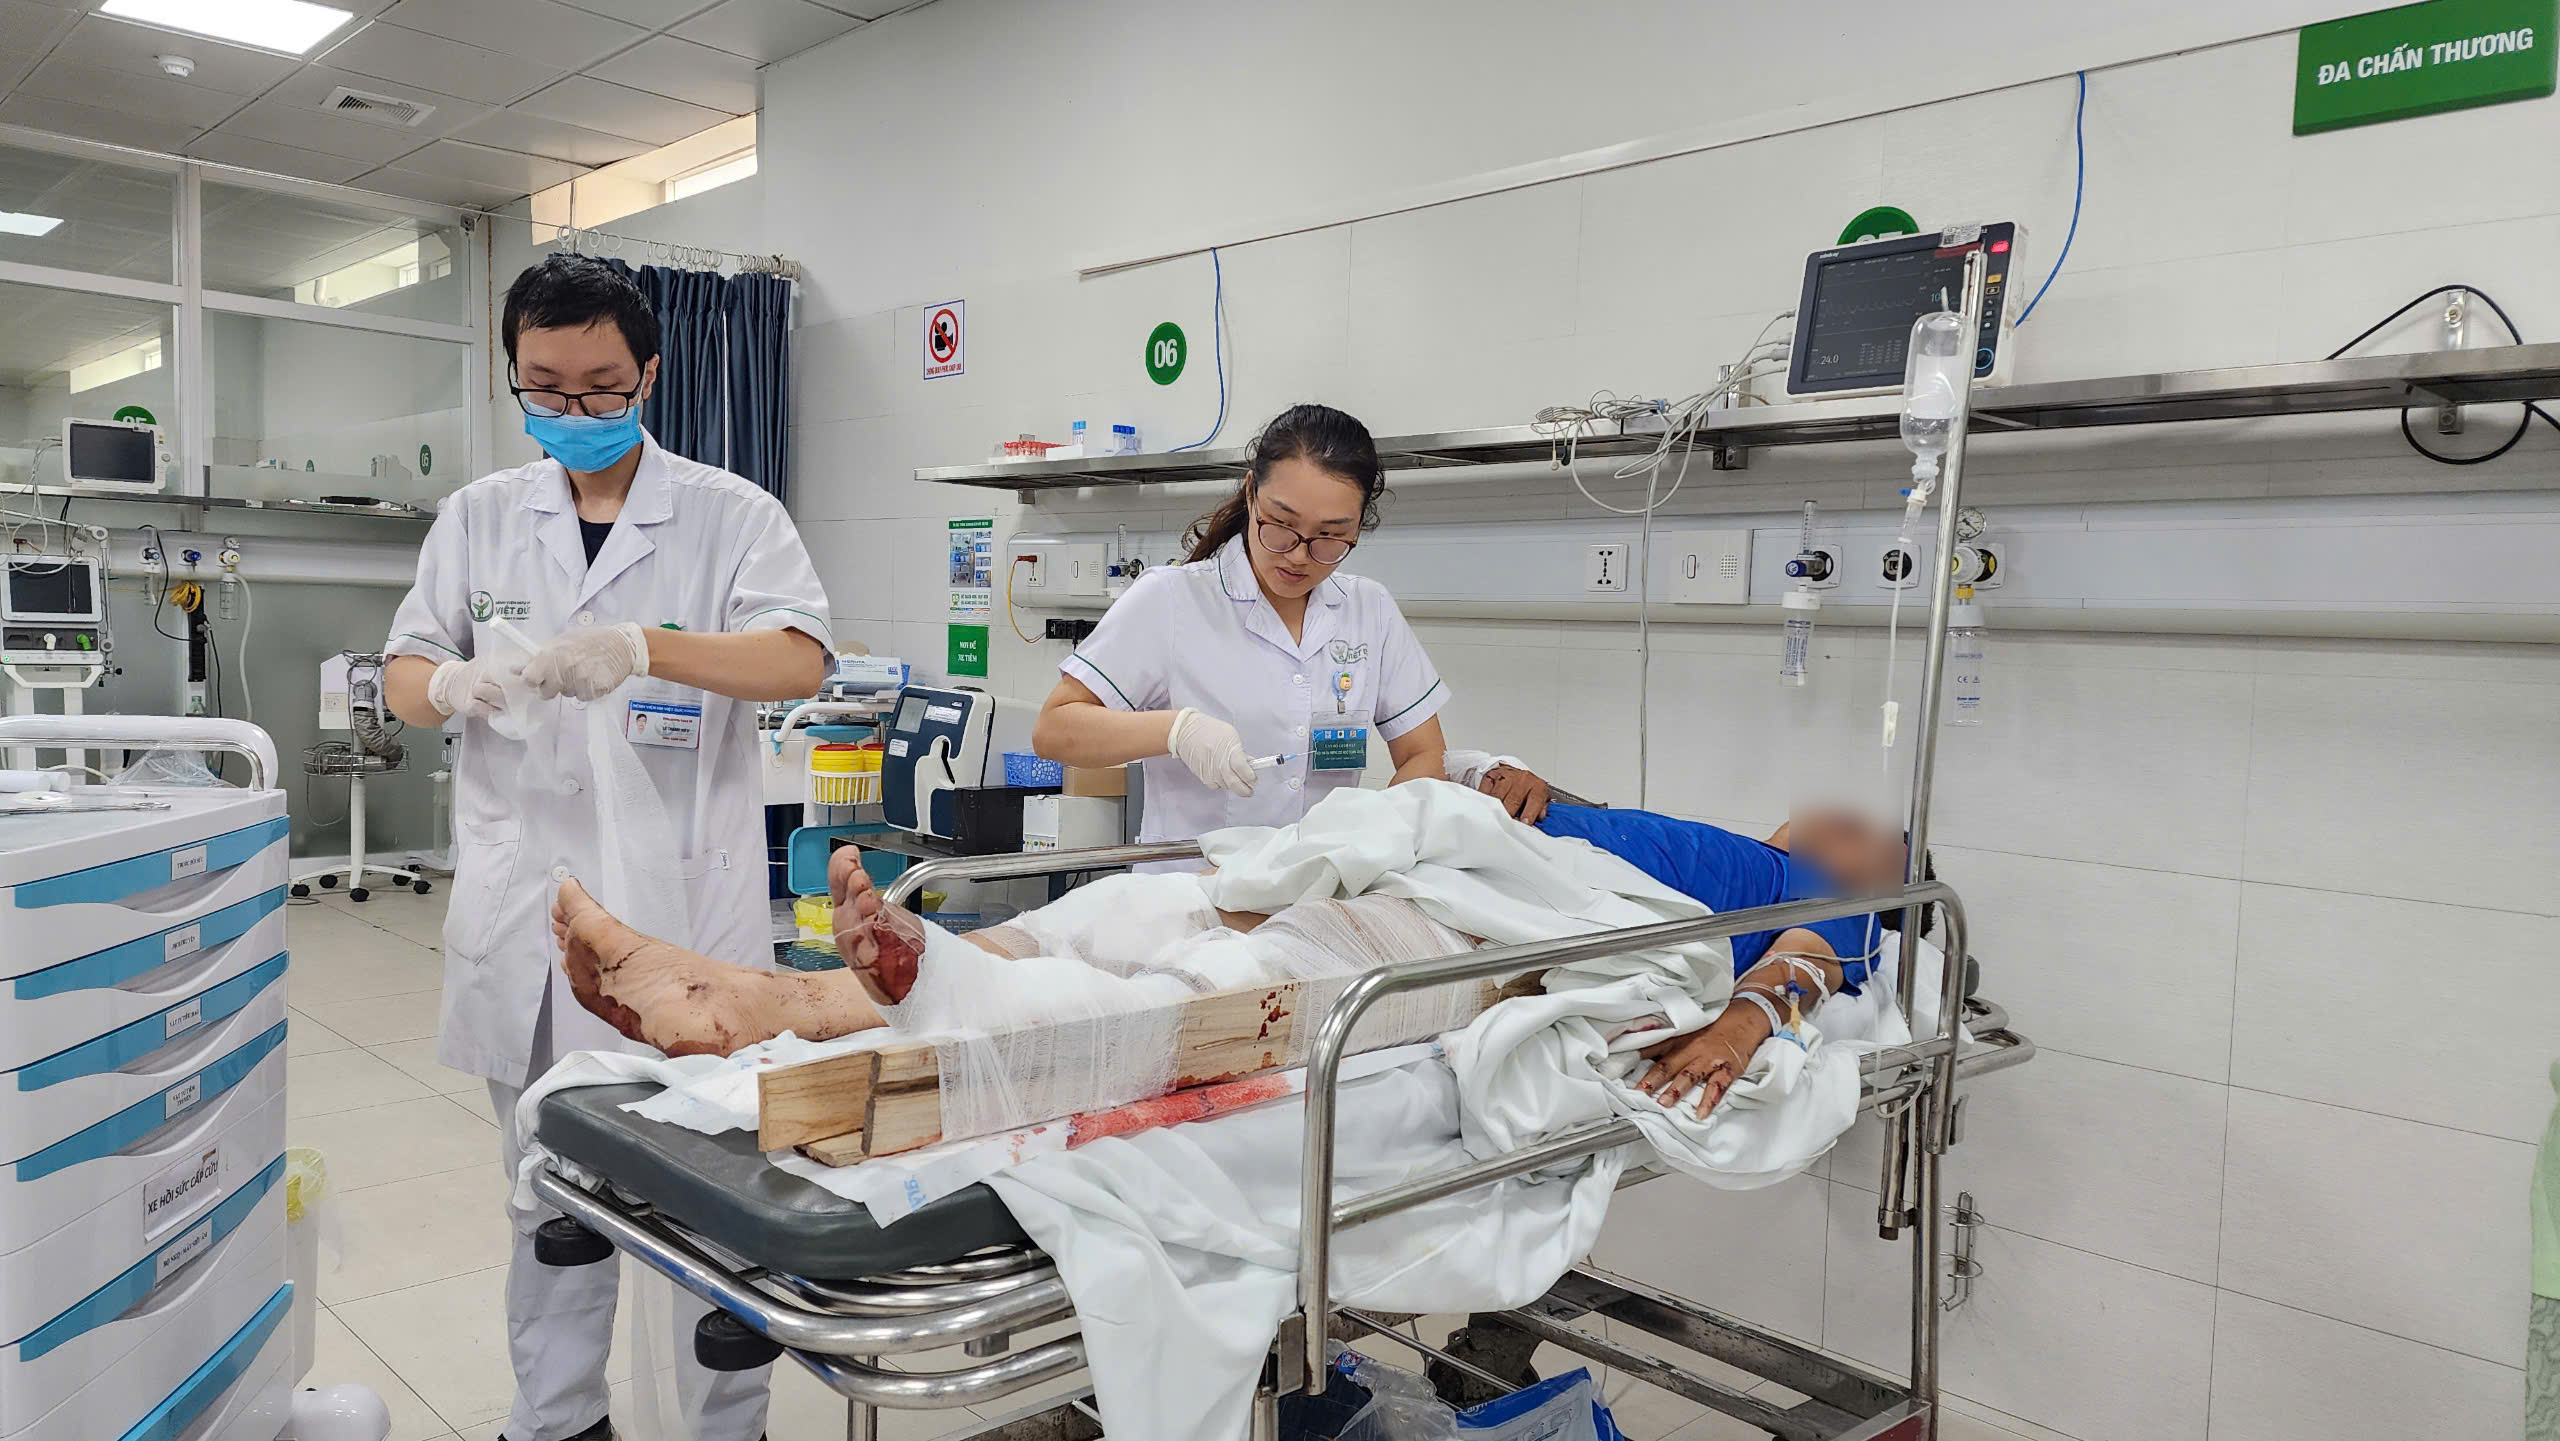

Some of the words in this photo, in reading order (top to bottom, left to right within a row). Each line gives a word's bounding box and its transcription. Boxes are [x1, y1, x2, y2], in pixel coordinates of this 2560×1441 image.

[2317, 61, 2352, 86] ĐA
[2357, 42, 2423, 79] CHẤN
[2430, 27, 2534, 65] THƯƠNG
[1153, 338, 1178, 369] 06
[495, 605, 516, 617] VIỆT
[147, 1198, 158, 1215] XE
[160, 1188, 174, 1207] HỒI
[175, 1180, 190, 1199] SỨC
[190, 1168, 204, 1189] CẤP
[204, 1160, 219, 1180] CỨU
